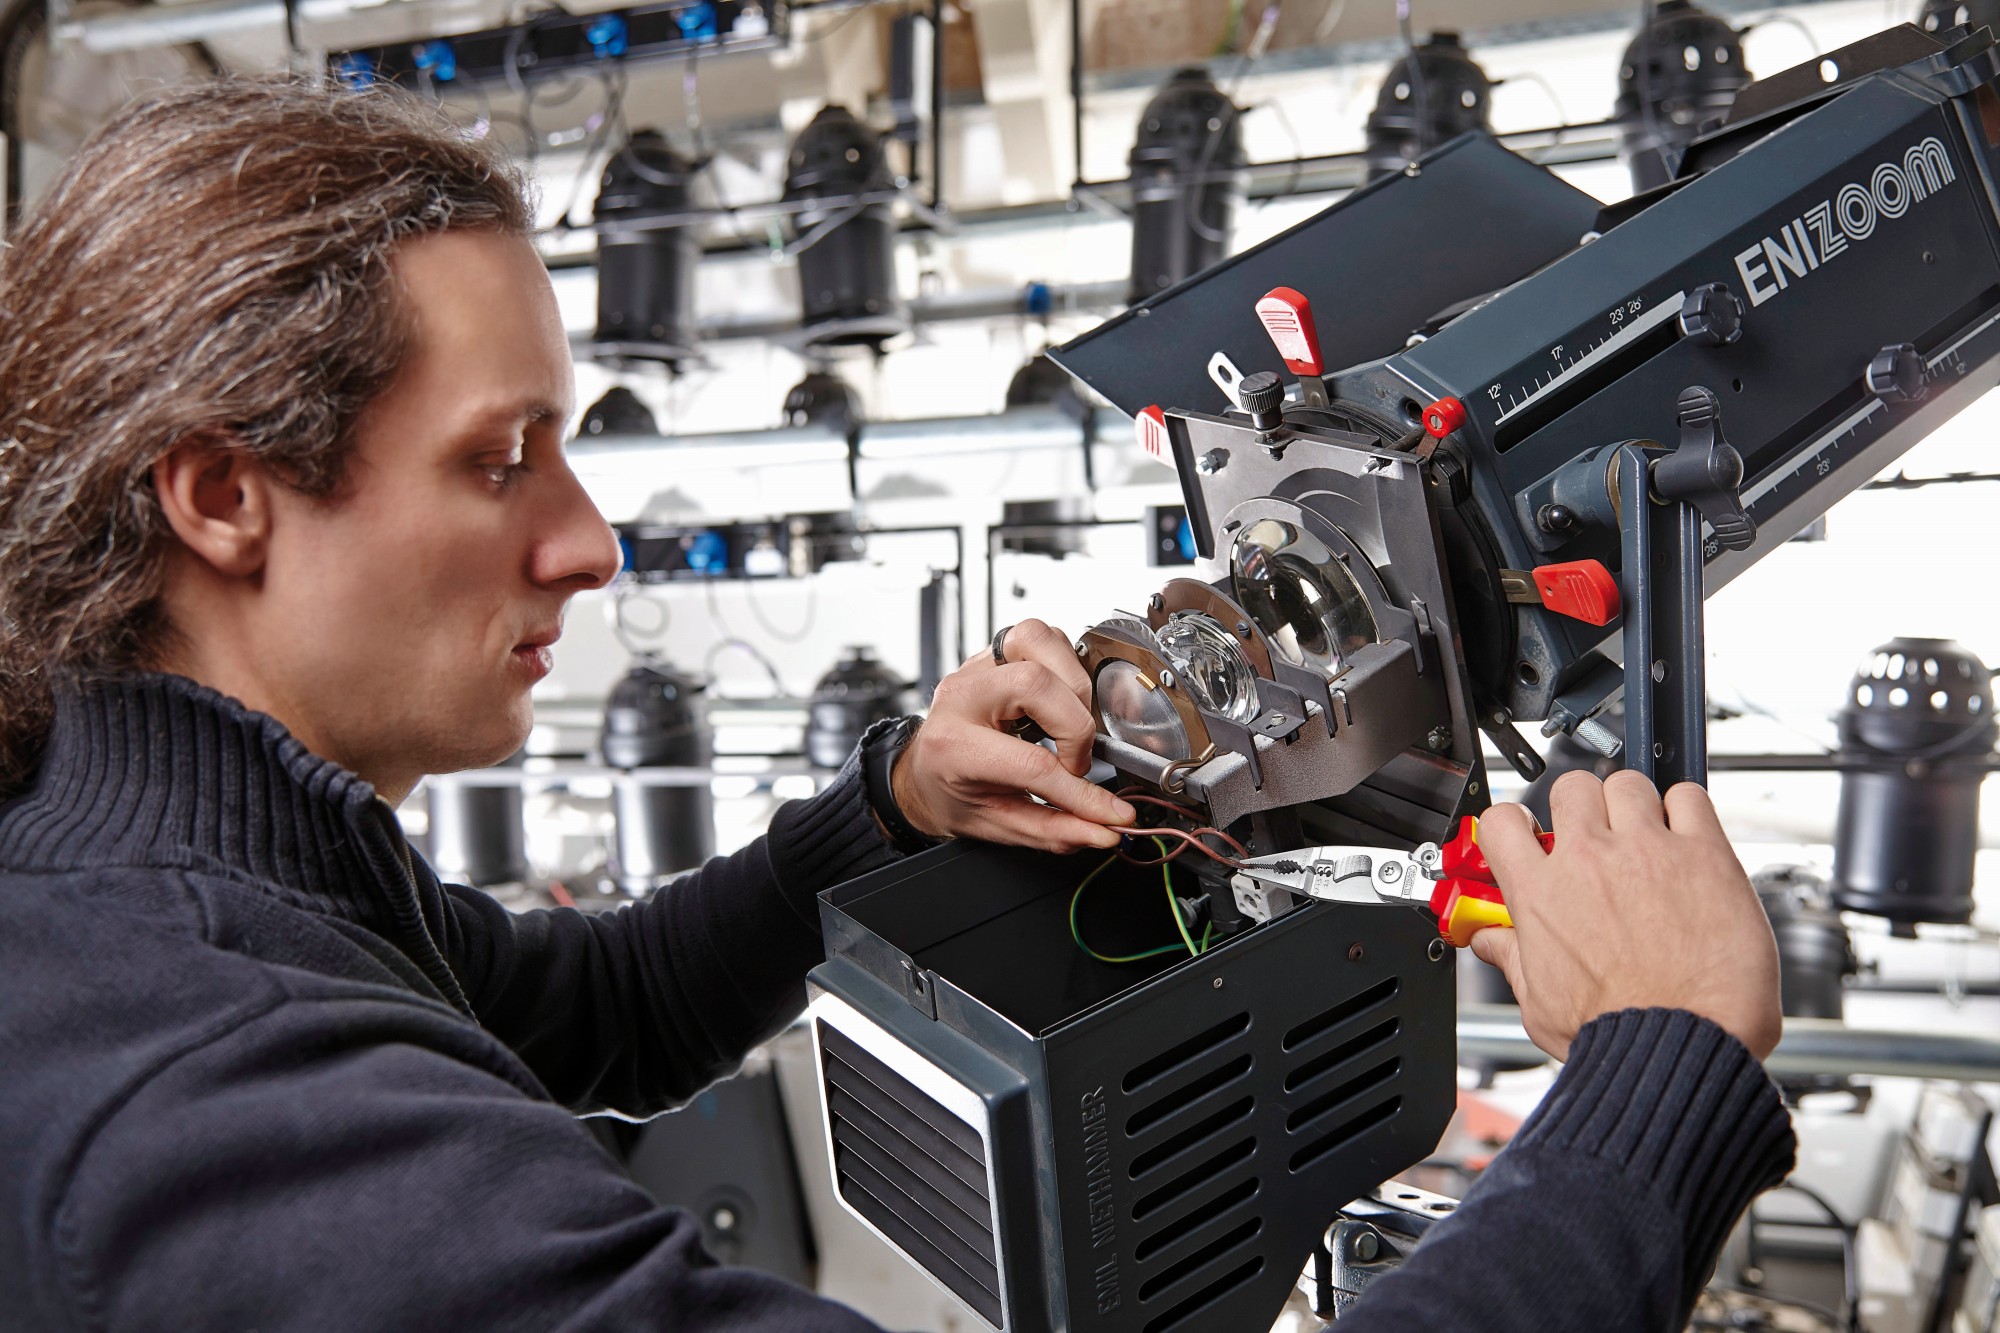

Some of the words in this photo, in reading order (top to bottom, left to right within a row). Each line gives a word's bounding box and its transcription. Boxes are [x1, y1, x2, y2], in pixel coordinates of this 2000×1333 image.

[1734, 136, 1956, 308] ENIZOOM
[1081, 1085, 1116, 1248] NIETHAMMER
[1095, 1253, 1121, 1315] EMIL
